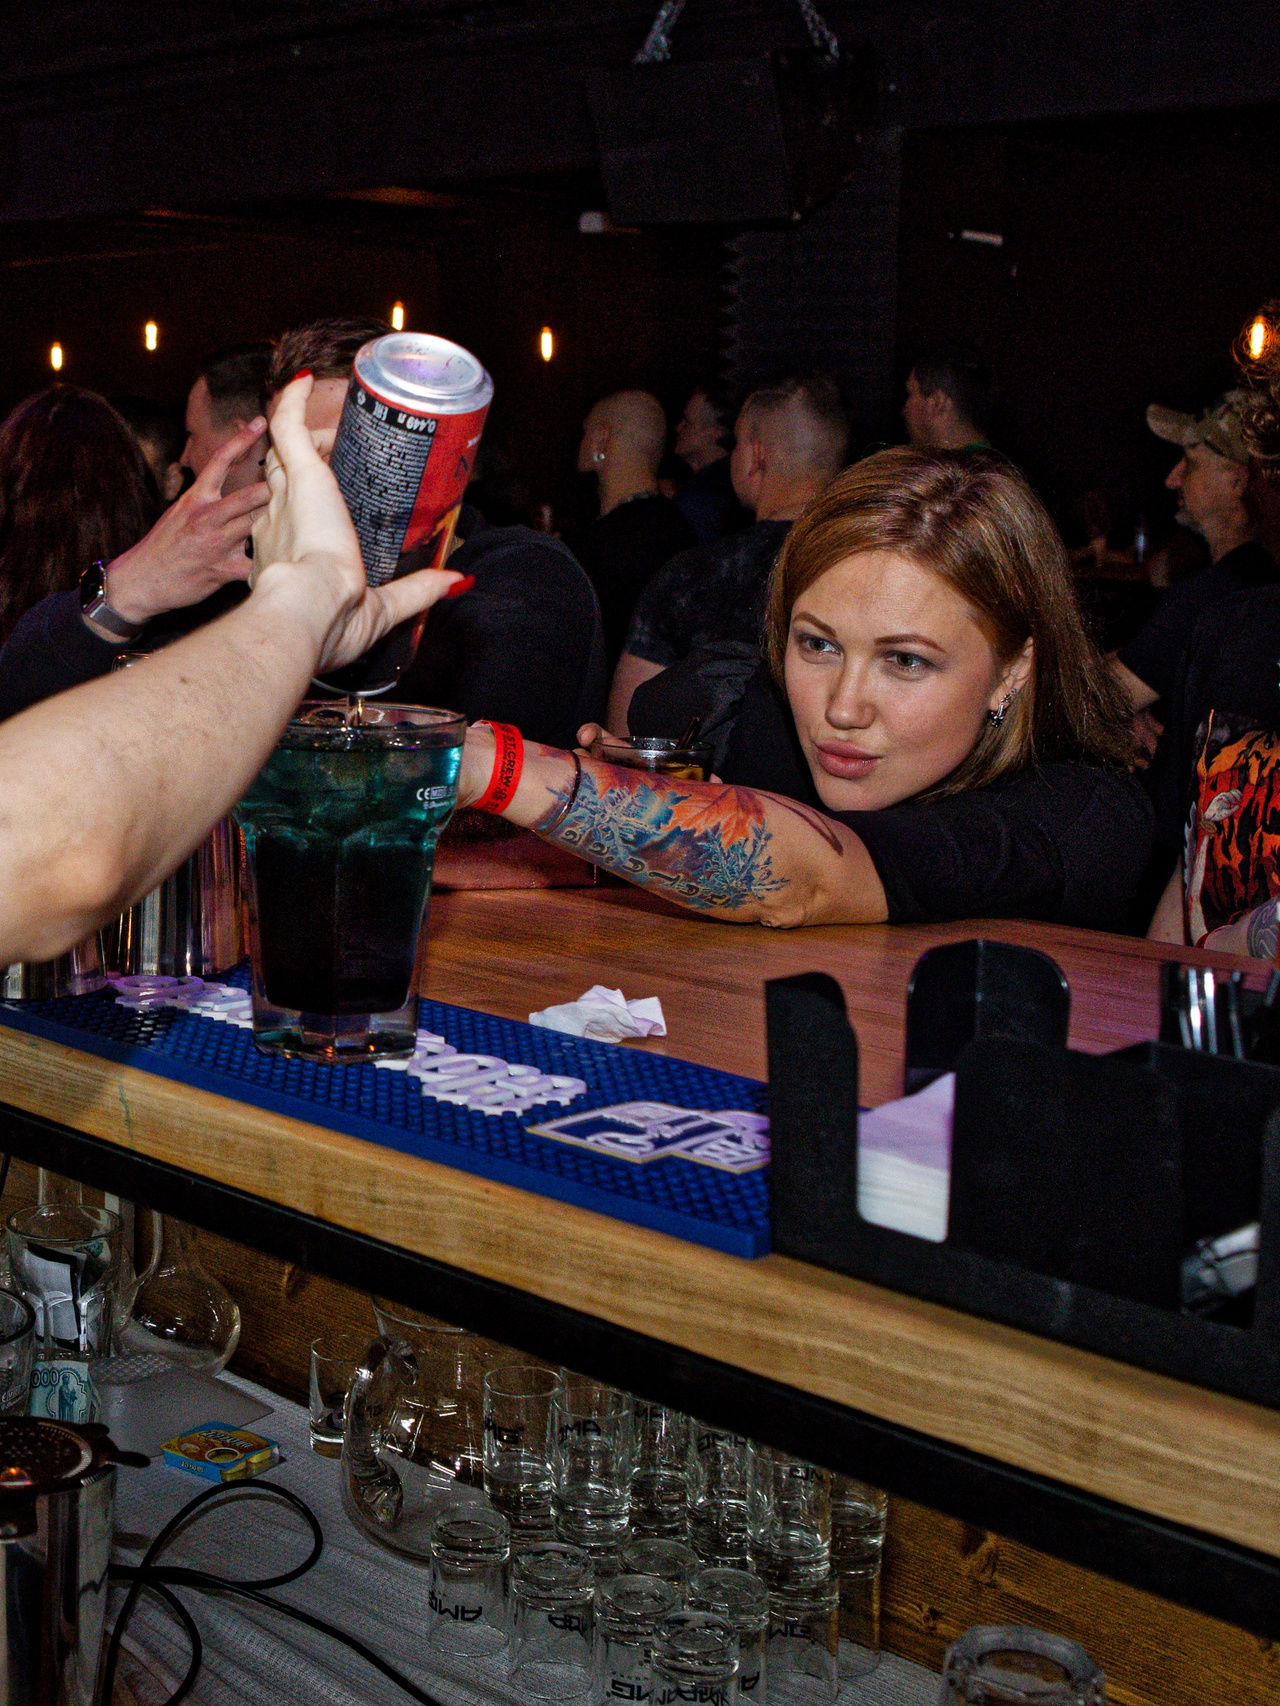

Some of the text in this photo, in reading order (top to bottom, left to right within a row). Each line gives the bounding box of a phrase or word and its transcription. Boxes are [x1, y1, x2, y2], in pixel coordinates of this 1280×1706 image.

[407, 417, 436, 433] 0,449
[506, 736, 517, 788] ST.CREW
[416, 788, 431, 801] CE
[31, 1369, 59, 1388] 000
